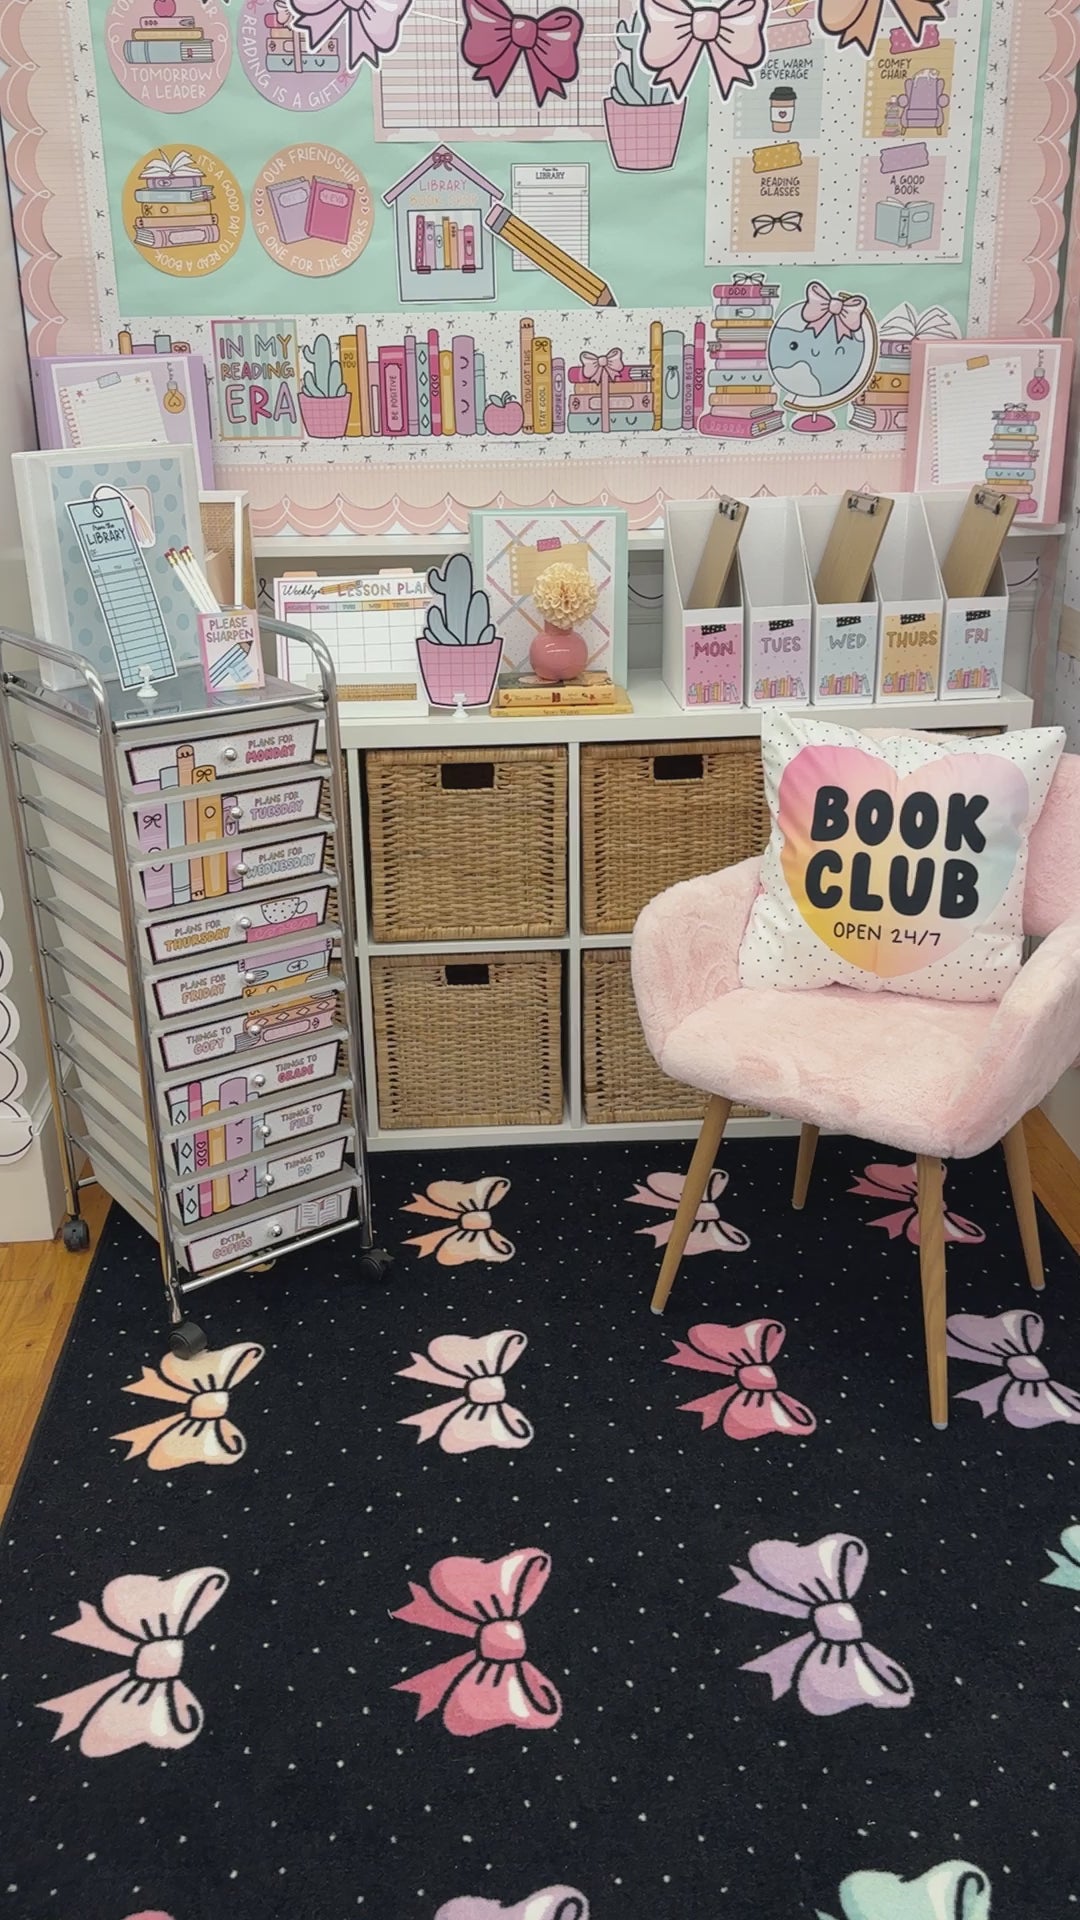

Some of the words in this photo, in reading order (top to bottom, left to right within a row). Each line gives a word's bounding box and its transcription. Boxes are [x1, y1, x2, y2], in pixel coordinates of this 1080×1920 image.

[241, 14, 271, 88] READING
[272, 86, 288, 102] IS
[292, 92, 301, 108] A
[308, 79, 340, 106] GIFT
[783, 59, 813, 68] WARM
[878, 58, 912, 68] COMFY
[130, 67, 213, 82] TOMORROW
[760, 69, 809, 80] BEVERAGE
[880, 69, 908, 79] CHAIR
[141, 85, 150, 99] A
[156, 84, 206, 99] LEADER
[263, 158, 287, 183] OUR
[288, 146, 360, 184] FRIENDSHIP
[214, 170, 224, 180] A
[536, 172, 565, 180] LIBRARY
[760, 177, 800, 187] READING
[890, 176, 896, 184] A
[900, 175, 924, 184] GOOD
[419, 180, 468, 192] LIBRARY
[760, 186, 800, 196] GLASSES
[894, 185, 919, 194] BOOK
[222, 180, 240, 212] GOOD
[228, 215, 240, 238] DAY
[220, 238, 234, 254] TO
[256, 222, 270, 234] IS
[266, 236, 288, 260] ONE
[290, 256, 313, 272] FOR
[318, 254, 341, 271] THE
[342, 218, 368, 258] BOOKS
[155, 250, 183, 271] BOOK
[186, 260, 193, 272] A
[196, 252, 220, 270] READ
[218, 335, 245, 360] IN
[254, 334, 292, 360] MY
[220, 361, 295, 381] READING
[524, 371, 532, 386] GOT
[389, 375, 398, 408] POSITIVE
[225, 381, 297, 425] ERA
[555, 393, 563, 420] INSPIRE
[685, 404, 692, 416] DO
[392, 411, 399, 420] BE
[86, 528, 126, 546] LIBRARY
[282, 584, 318, 600] Weekly
[209, 616, 248, 630] PLEASE
[206, 628, 254, 643] SHARPEN
[828, 634, 867, 650] WED
[886, 630, 938, 648] THURS
[964, 628, 989, 644] FRI
[693, 640, 734, 658] MON
[760, 636, 802, 654] TUES
[248, 737, 276, 750] PLANS
[278, 734, 293, 744] FOR
[245, 744, 296, 764] MONDAY
[254, 794, 282, 806] PLANS
[284, 791, 299, 802] FOR
[250, 800, 304, 822] TUESDAY
[811, 786, 989, 854] BOOK
[258, 850, 285, 864] PLANS
[287, 847, 302, 858] FOR
[246, 853, 316, 879] WEDNESDAY
[805, 850, 979, 919] CLUB
[174, 924, 202, 937] PLANS
[205, 920, 220, 930] FOR
[833, 921, 882, 940] OPEN
[890, 928, 942, 947] 24/7
[164, 927, 230, 952] THURSDAY
[180, 978, 208, 992] PLANS
[210, 974, 226, 984] FOR
[181, 983, 226, 1004] FRIDAY
[186, 1029, 218, 1044] THINGS
[220, 1026, 232, 1035] TO
[193, 1038, 225, 1056] COPY
[276, 1059, 304, 1072] THINGS
[307, 1054, 318, 1062] TO
[277, 1064, 314, 1084] GRADE
[280, 1108, 310, 1122] THINGS
[312, 1104, 322, 1112] TO
[290, 1114, 314, 1131] FILE
[284, 1156, 314, 1170] THINGS
[314, 1150, 325, 1160] TO
[298, 1164, 312, 1177] DO
[220, 1231, 246, 1246] EXTRA
[212, 1236, 252, 1260] COPIES
